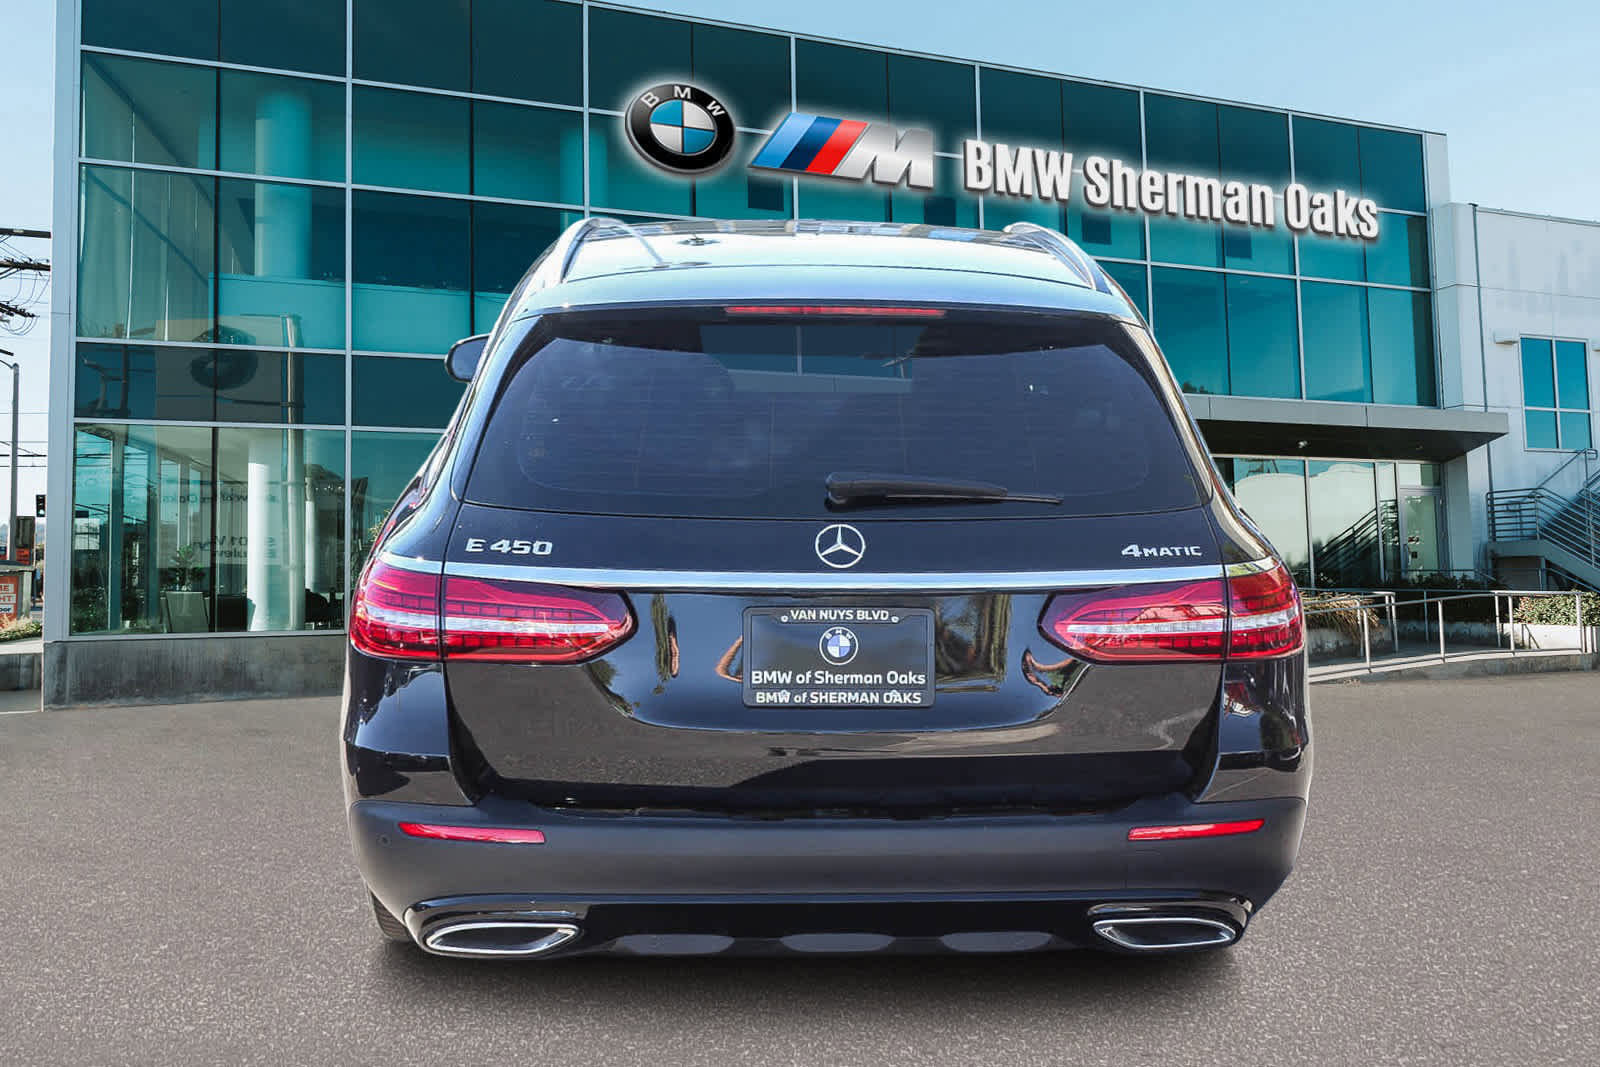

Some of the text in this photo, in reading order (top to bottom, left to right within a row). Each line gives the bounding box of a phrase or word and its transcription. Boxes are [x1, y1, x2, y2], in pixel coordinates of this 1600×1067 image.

[641, 85, 725, 117] BMW
[963, 139, 1380, 240] BMW Sherman Oaks
[465, 538, 553, 555] E 450
[1121, 544, 1202, 557] 4MATIC
[790, 610, 889, 621] VAN NUYS BLVD
[752, 671, 926, 684] BMW of Sherman Oaks
[756, 692, 922, 704] BMW of SHERMAN OAKS
